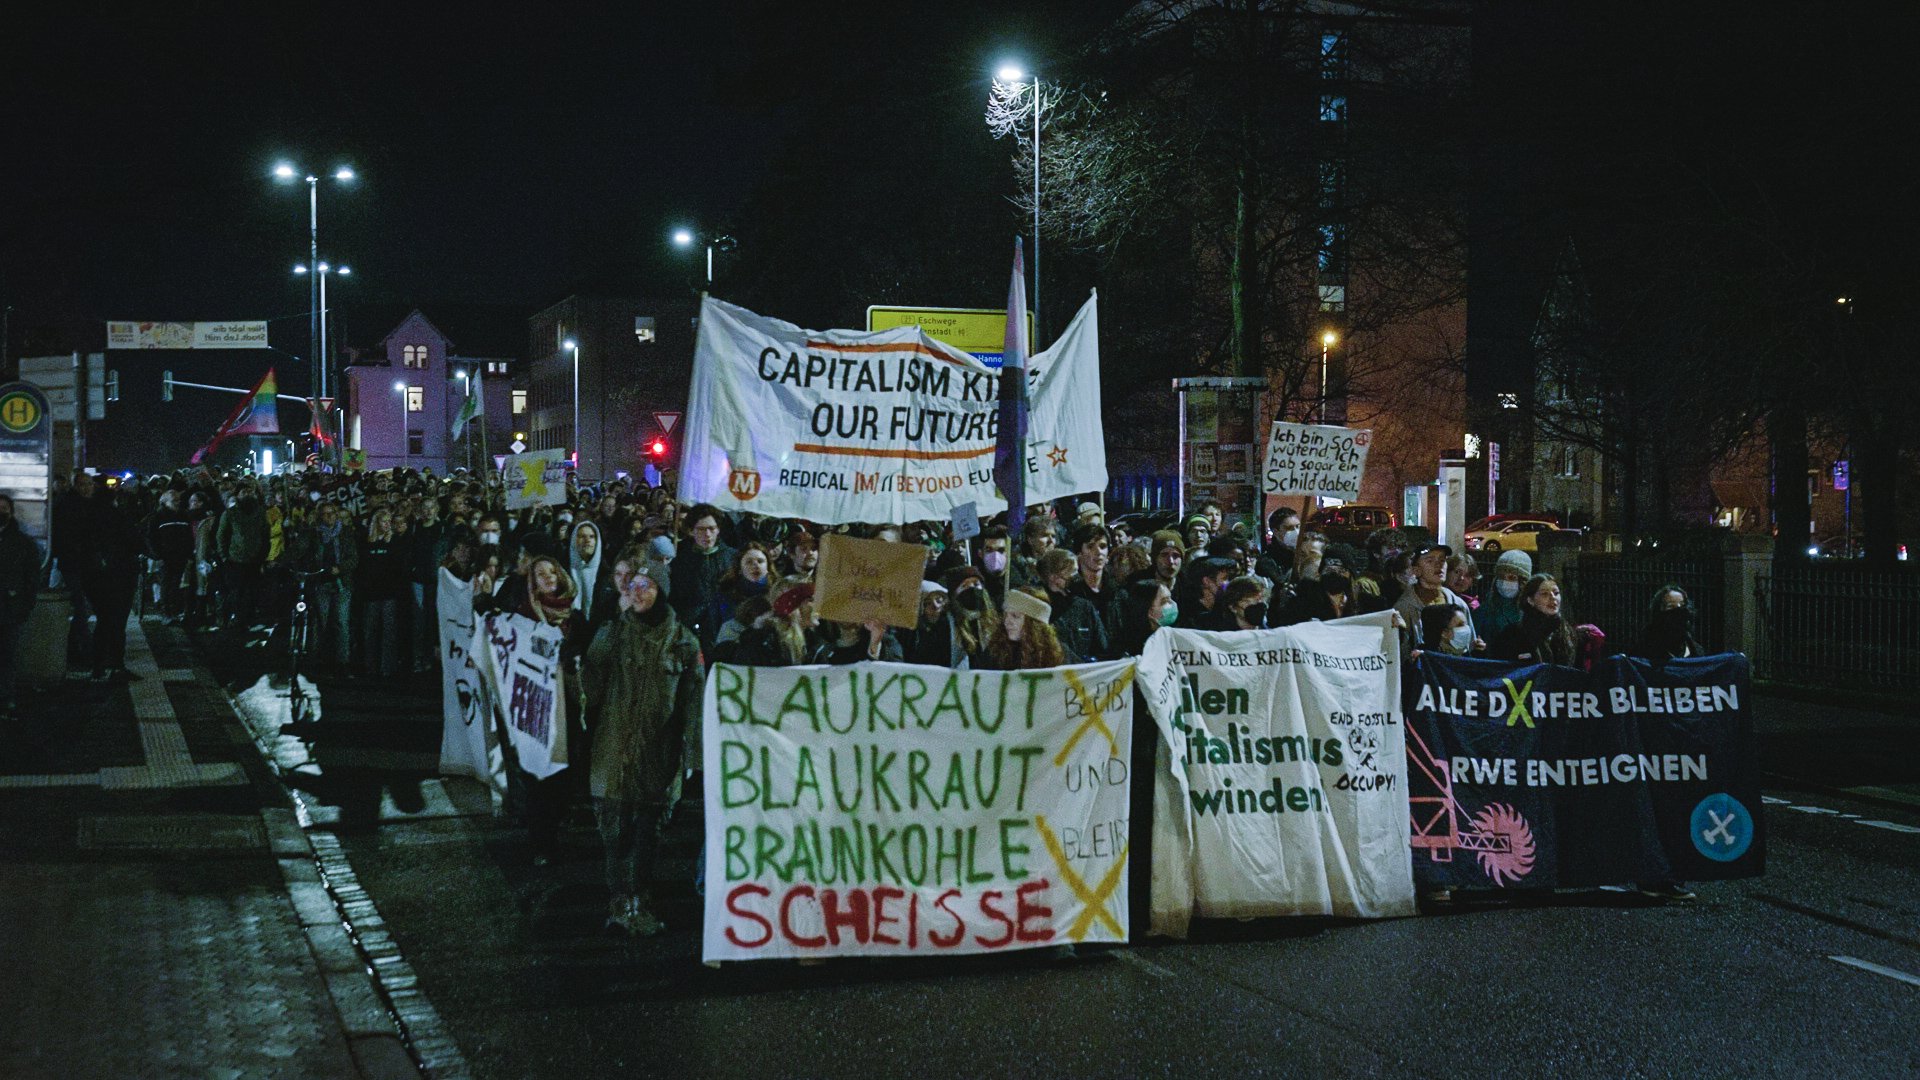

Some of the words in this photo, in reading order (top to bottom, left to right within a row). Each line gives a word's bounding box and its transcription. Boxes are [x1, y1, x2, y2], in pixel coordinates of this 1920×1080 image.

[918, 317, 957, 325] Eschwege
[924, 328, 951, 336] enstadt
[758, 346, 950, 398] CAPITALISM
[978, 355, 1003, 363] Hanno
[9, 400, 28, 423] H
[811, 402, 878, 441] OUR
[1274, 428, 1296, 443] Ich
[1300, 429, 1324, 446] bin
[1273, 443, 1330, 459] wütend,
[1270, 454, 1296, 470] hab
[1300, 460, 1335, 477] sogar
[1338, 460, 1358, 472] ein
[779, 468, 849, 492] REDICAL
[896, 474, 963, 494] BEYOND
[1266, 469, 1316, 492] Schild
[1317, 473, 1359, 493] dabei.
[1217, 652, 1252, 668] DER
[1256, 648, 1311, 667] KRISEN
[714, 663, 1054, 734] BLAUKRAUT
[1182, 672, 1250, 716] ilen
[1416, 683, 1479, 717] ALLE
[1609, 684, 1739, 714] BLEIBEN
[1329, 711, 1354, 725] END
[1358, 711, 1397, 725] FOSSIL
[1184, 721, 1343, 768] italismus
[720, 740, 1045, 813] BLAUKRAUT
[1066, 757, 1128, 792] UND
[1334, 772, 1397, 793] OCCUPY!
[1451, 756, 1517, 786] RWE
[1526, 753, 1708, 787] ENTEIGNEN
[1189, 777, 1323, 818] winden
[725, 818, 1031, 887] BRAUNKOHLE
[723, 878, 1056, 949] SCHEISSE
